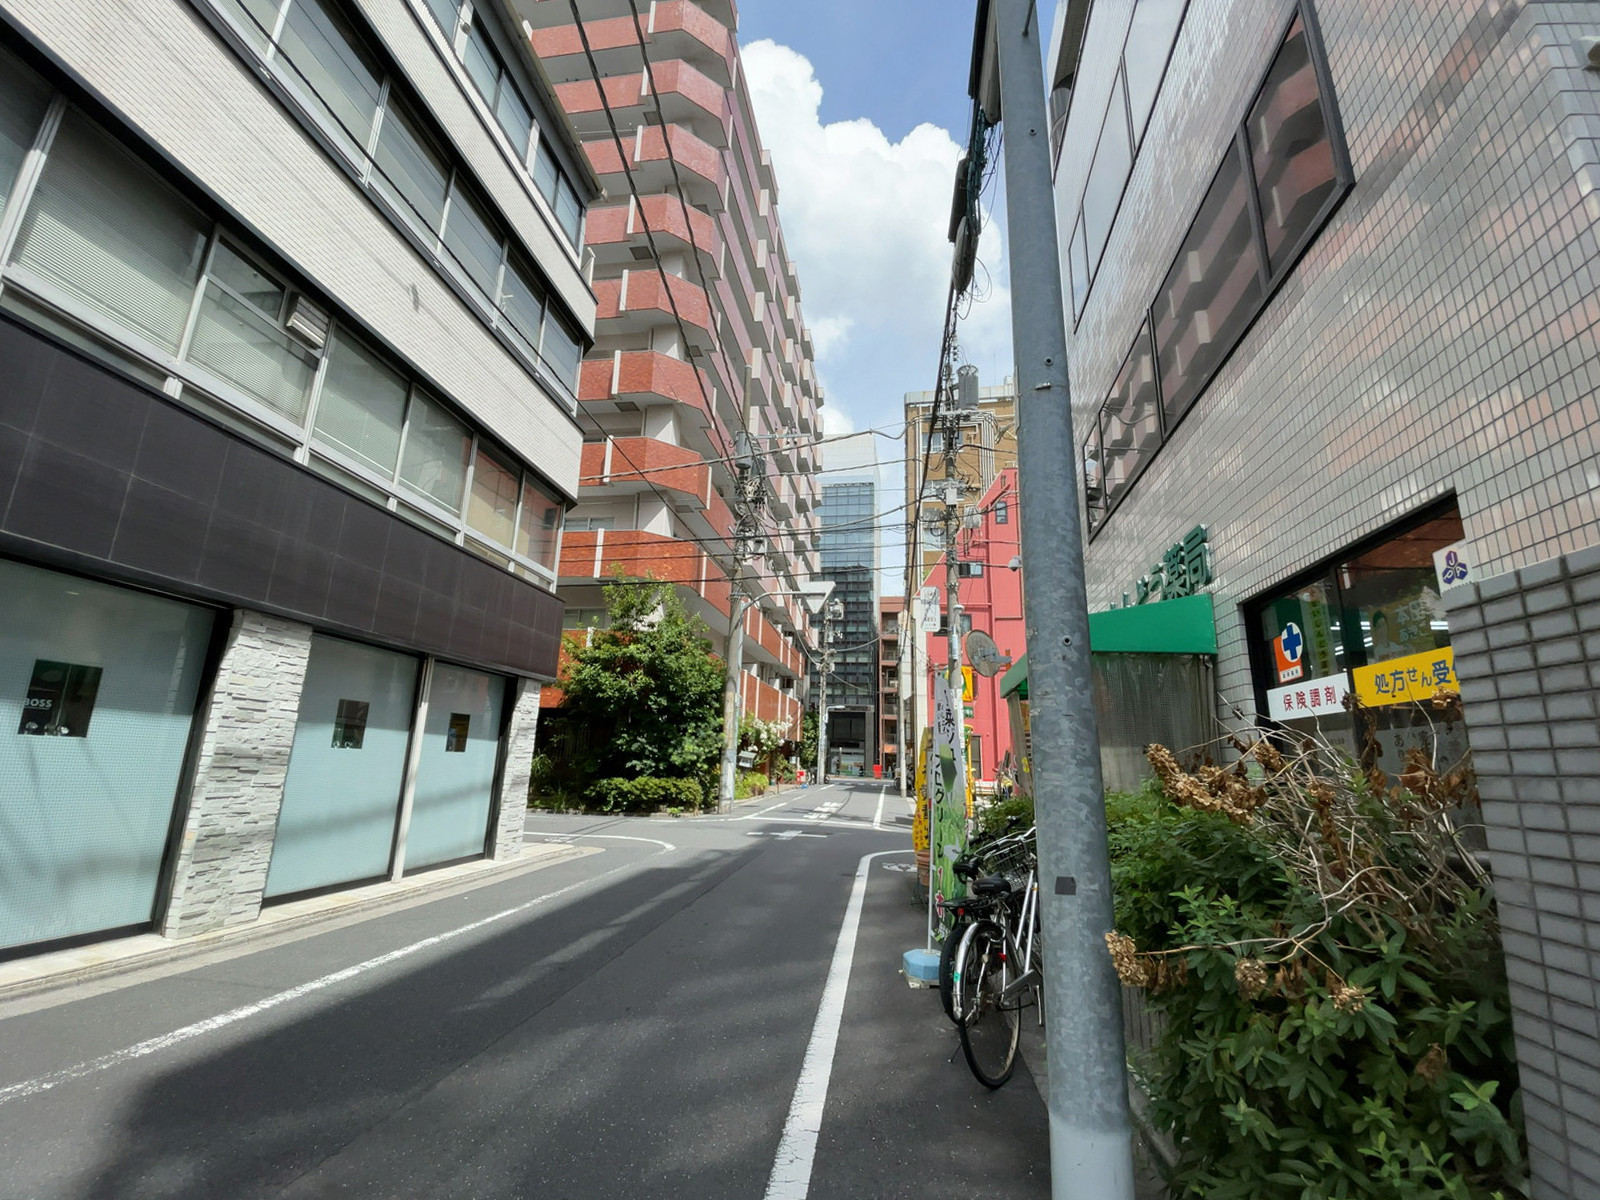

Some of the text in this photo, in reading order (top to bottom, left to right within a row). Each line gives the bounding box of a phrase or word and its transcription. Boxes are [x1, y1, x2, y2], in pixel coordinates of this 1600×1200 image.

[1375, 659, 1460, 694] 処方せん受
[1283, 685, 1336, 711] 保険調剤
